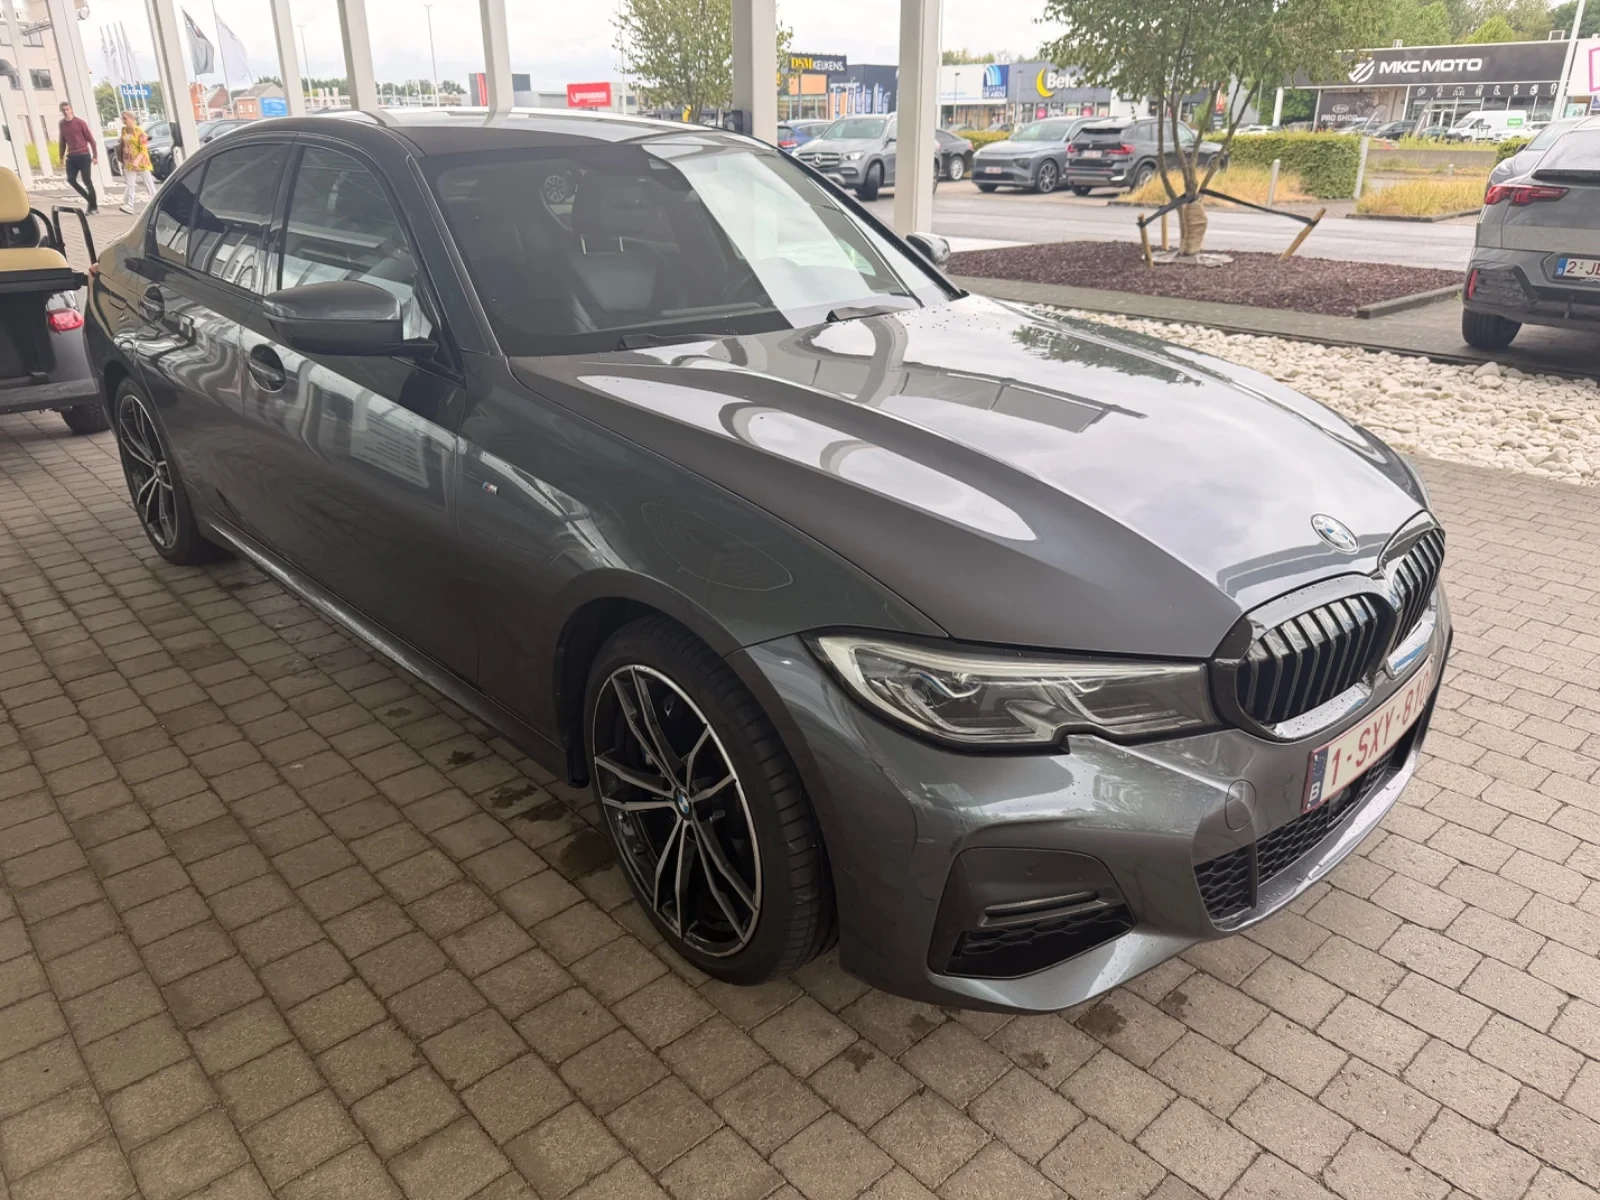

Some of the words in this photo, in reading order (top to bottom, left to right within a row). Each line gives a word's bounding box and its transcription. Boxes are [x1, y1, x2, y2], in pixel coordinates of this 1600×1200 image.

[1379, 60, 1421, 74] MKC
[1422, 58, 1483, 73] MOTO
[1309, 781, 1321, 801] B
